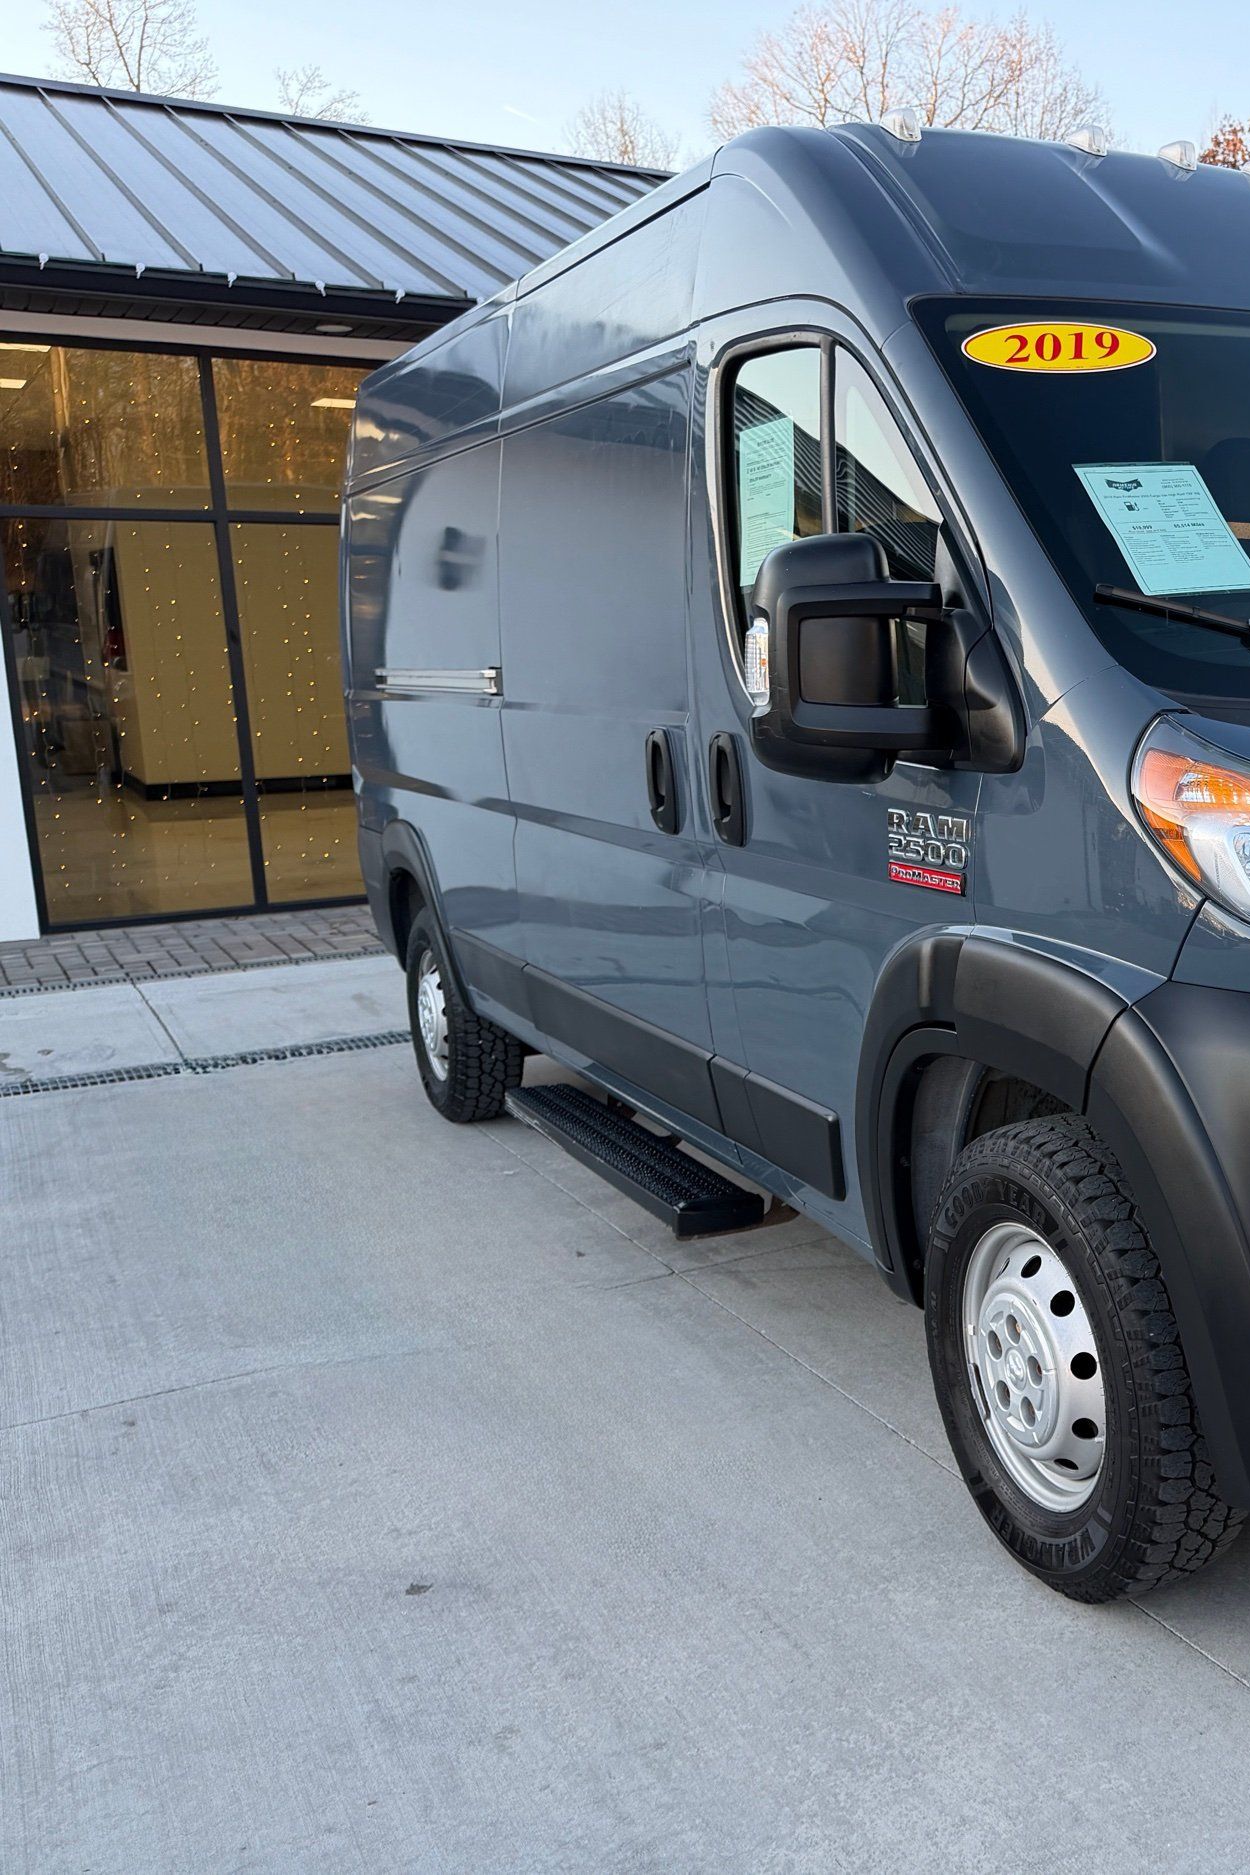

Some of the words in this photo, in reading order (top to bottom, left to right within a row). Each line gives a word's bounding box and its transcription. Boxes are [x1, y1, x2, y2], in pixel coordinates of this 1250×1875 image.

[1004, 331, 1120, 363] 2019
[887, 808, 970, 842] RAM
[888, 834, 969, 869] 2500
